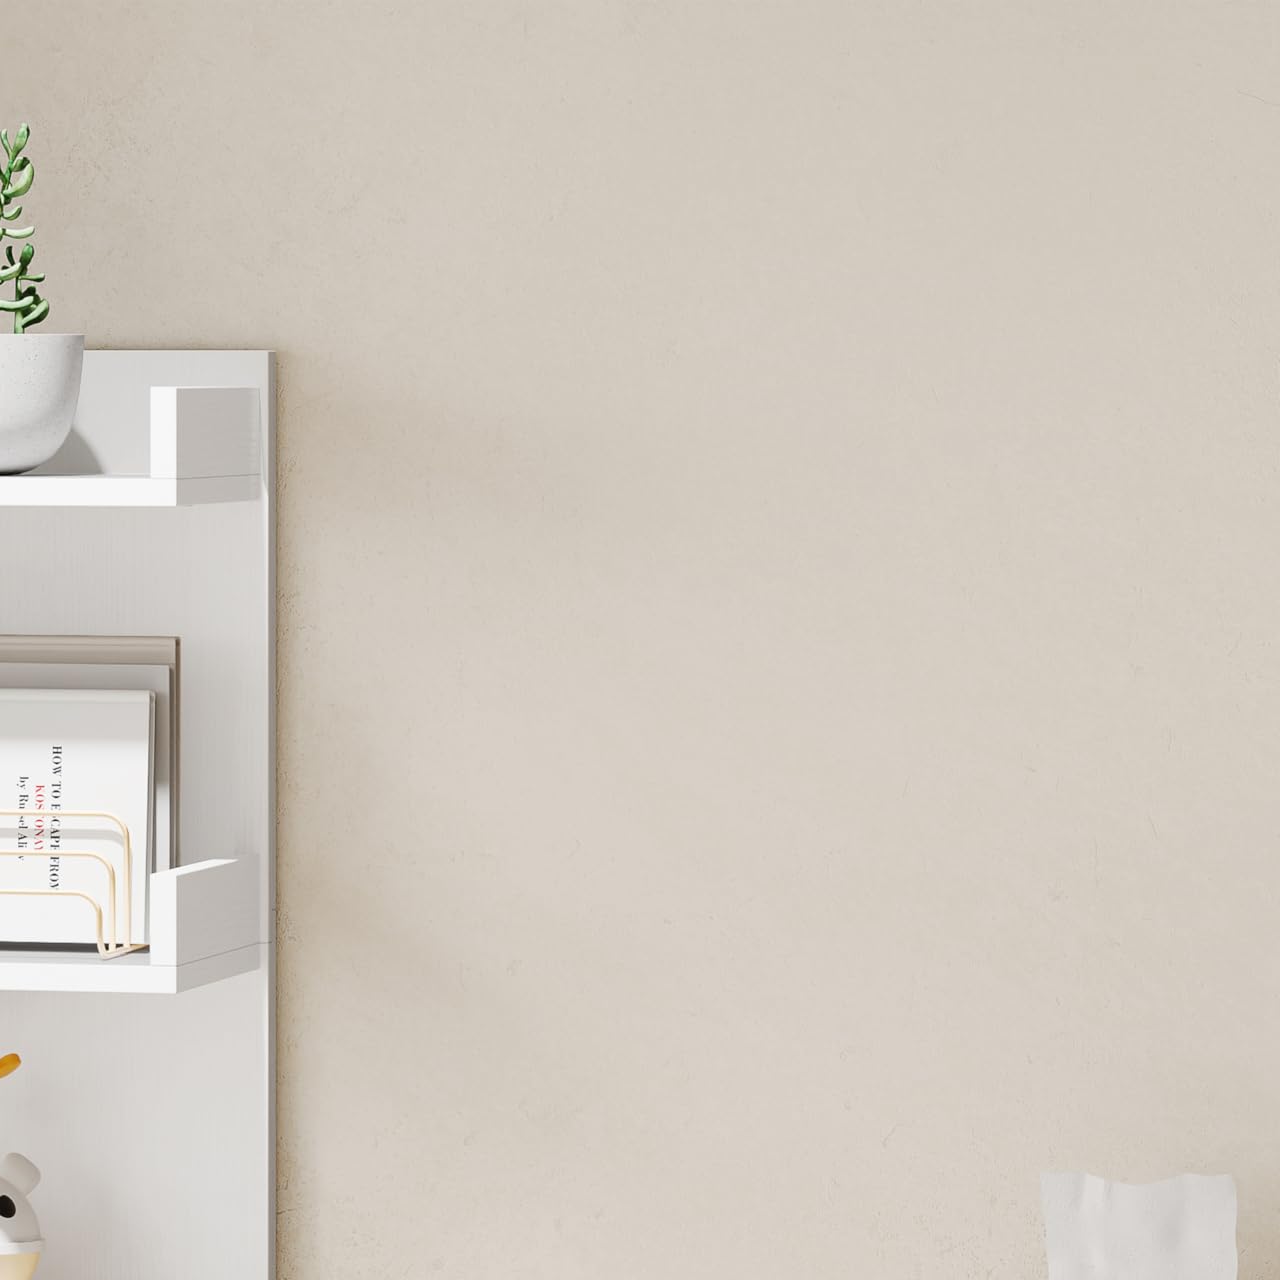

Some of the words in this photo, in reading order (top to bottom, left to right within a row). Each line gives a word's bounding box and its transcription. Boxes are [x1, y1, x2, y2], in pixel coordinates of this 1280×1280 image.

[52, 746, 63, 776] HOW
[16, 776, 29, 789] by
[51, 781, 62, 799] TO
[50, 803, 61, 851] ECAPE
